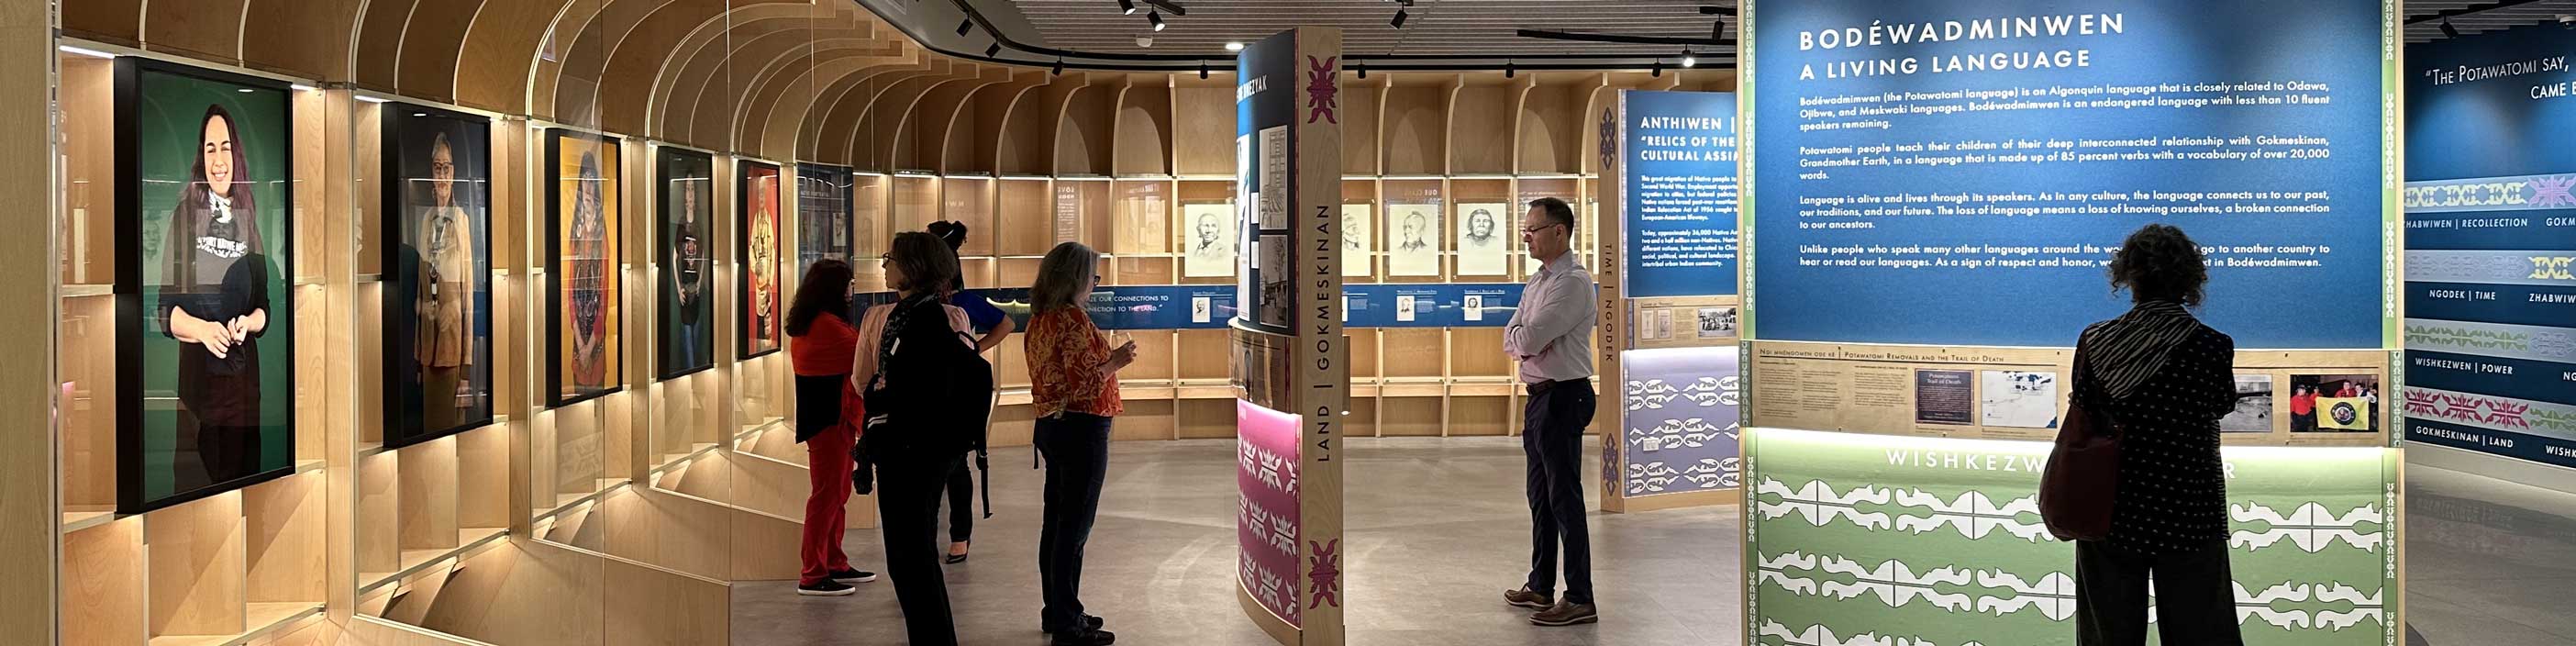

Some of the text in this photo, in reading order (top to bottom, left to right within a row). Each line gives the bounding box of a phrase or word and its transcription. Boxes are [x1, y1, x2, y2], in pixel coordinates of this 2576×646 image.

[1800, 13, 2124, 50] BODÉWADMINWEN
[1800, 50, 2088, 80] A LIVING LANGUAGE
[1882, 91, 1903, 104] (the
[1904, 89, 1963, 101] Potawatomi
[1965, 86, 2018, 100] language)
[2021, 87, 2030, 96] is
[2032, 88, 2046, 96] an
[2049, 84, 2104, 98] Algonquin
[2105, 84, 2157, 96] language
[2159, 82, 2181, 93] that
[2182, 83, 2192, 93] is
[2193, 81, 2231, 95] closely
[2233, 81, 2271, 92] related
[2272, 82, 2284, 91] to
[2286, 81, 2329, 92] Odawa,
[2531, 83, 2566, 98] CAME
[1799, 108, 1836, 120] Ojibwe,
[1838, 106, 1857, 117] and
[1859, 104, 1907, 116] Meskwaki
[1910, 103, 1966, 116] languages.
[2062, 99, 2071, 108] is
[2073, 100, 2088, 108] an
[2090, 95, 2155, 109] endangered
[2157, 95, 2208, 108] language
[2210, 95, 2233, 106] with
[2236, 95, 2256, 105] less
[2258, 94, 2282, 105] than
[2286, 94, 2299, 105] 10
[2301, 94, 2330, 105] fluent
[1641, 117, 1721, 129] ANTHIWEN
[1799, 118, 1892, 133] speakers remaining.
[1692, 137, 1706, 147] OF
[1712, 137, 1735, 147] THE
[1799, 134, 2329, 155] Potawatomi people teach their children of their deep interconnected relationship with Gokmeskinan,
[1641, 150, 1699, 161] CULTURAL
[1799, 169, 1829, 180] words.
[1799, 195, 1845, 206] Language
[1847, 195, 1855, 204] is
[1857, 194, 1881, 204] alive
[1882, 193, 1903, 204] and
[1904, 192, 1928, 203] lives
[1930, 192, 1969, 205] through
[1971, 193, 1983, 202] its
[1986, 191, 2036, 204] speakers.
[2038, 191, 2052, 201] As
[2055, 191, 2065, 201] in
[2068, 193, 2089, 203] any
[2091, 190, 2130, 202] culture,
[2133, 189, 2150, 200] the
[2152, 189, 2204, 202] language
[2205, 190, 2253, 200] connects
[2270, 190, 2282, 199] to
[2304, 190, 2329, 202] past,
[2462, 218, 2527, 227] RECOLLECTION
[1799, 243, 2123, 256] Unlike people who speak many other languages around the wor
[2200, 242, 2330, 256] go to another country to
[1799, 256, 1821, 266] hear
[1835, 256, 1857, 266] read
[1878, 256, 1932, 269] languages.
[1935, 257, 1949, 266] As
[1960, 257, 1982, 269] sign
[1984, 256, 1996, 266] of
[1998, 258, 2036, 269] respect
[2037, 256, 2060, 267] and
[2061, 256, 2096, 268] honor,
[2214, 258, 2224, 267] in
[2429, 289, 2496, 300] NGODEK TIME
[1604, 244, 1614, 362] TIME NGODEK
[1316, 206, 1330, 462] LAND GOKMESKINAN
[1886, 352, 1919, 361] REMOVALS
[2415, 359, 2512, 373] WISHKEZWEN POWER
[2415, 426, 2513, 447] GOKMESKINAN LAND
[1886, 449, 2046, 473] WISHKEZW
